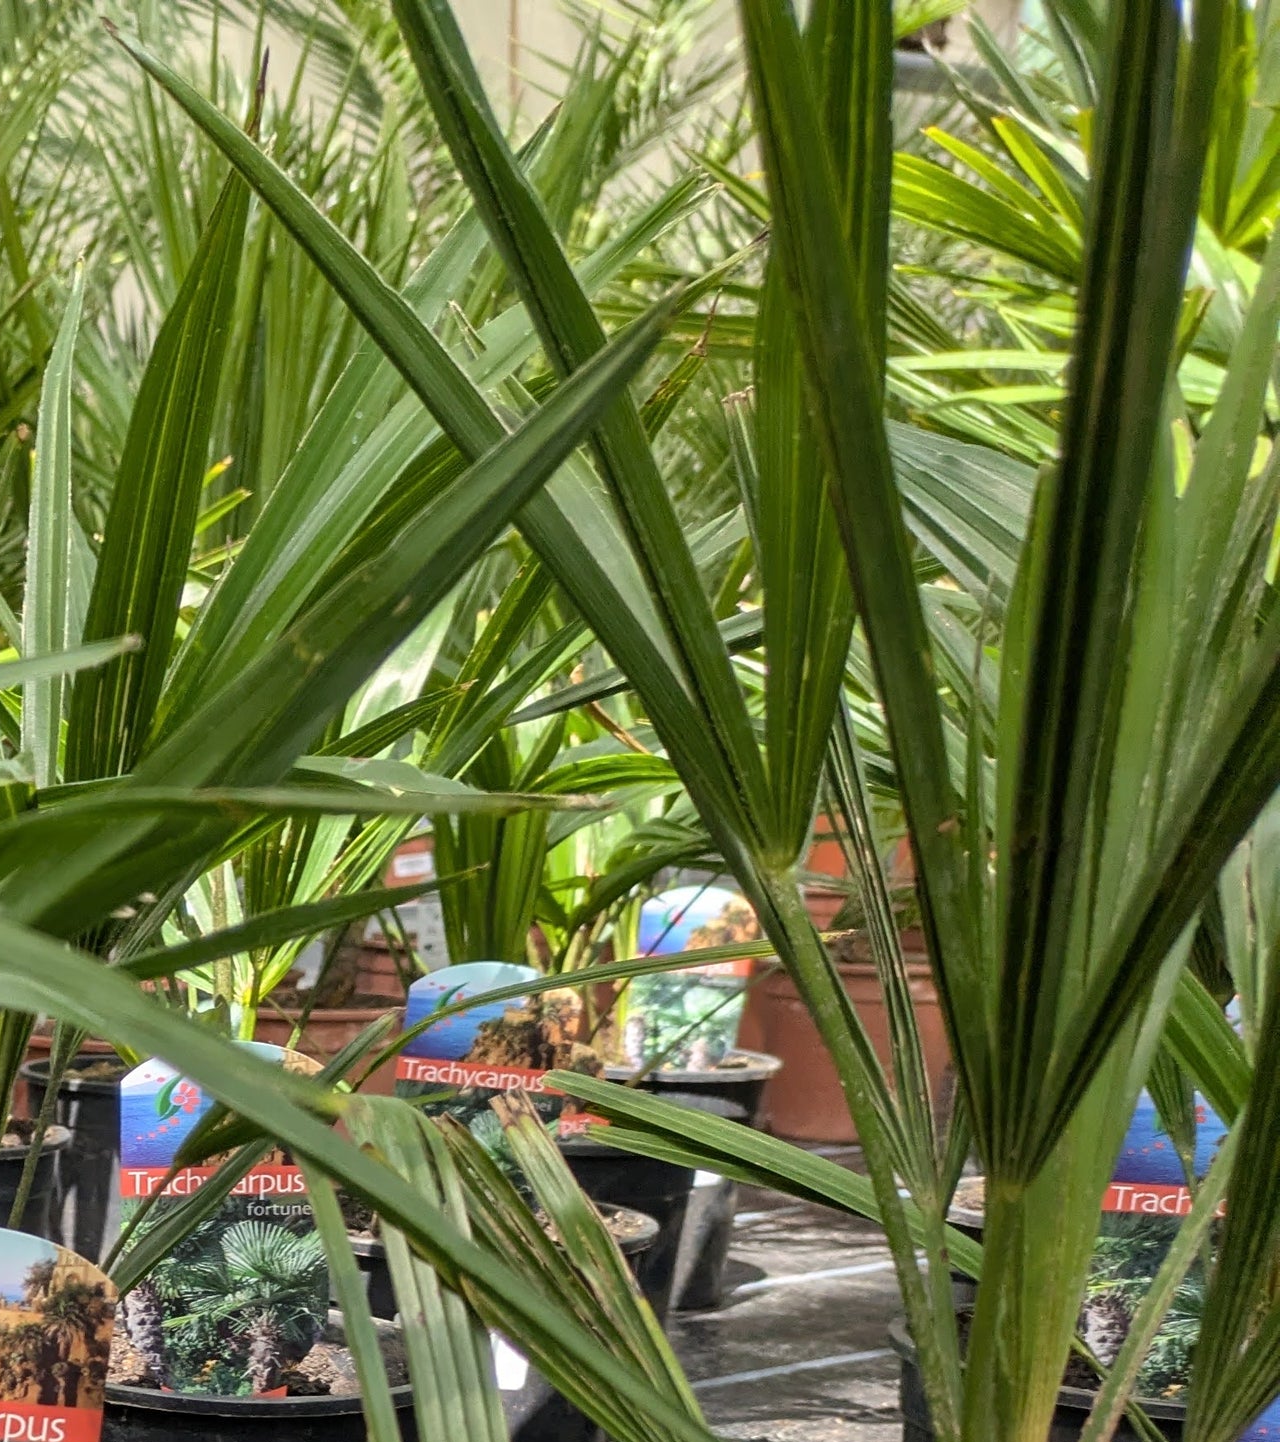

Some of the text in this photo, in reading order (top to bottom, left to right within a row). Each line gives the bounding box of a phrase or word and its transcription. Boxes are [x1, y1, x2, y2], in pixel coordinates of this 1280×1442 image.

[404, 1058, 545, 1096] Trachycarpus
[128, 1168, 306, 1200] Trcharpus
[246, 1203, 314, 1217] fortune
